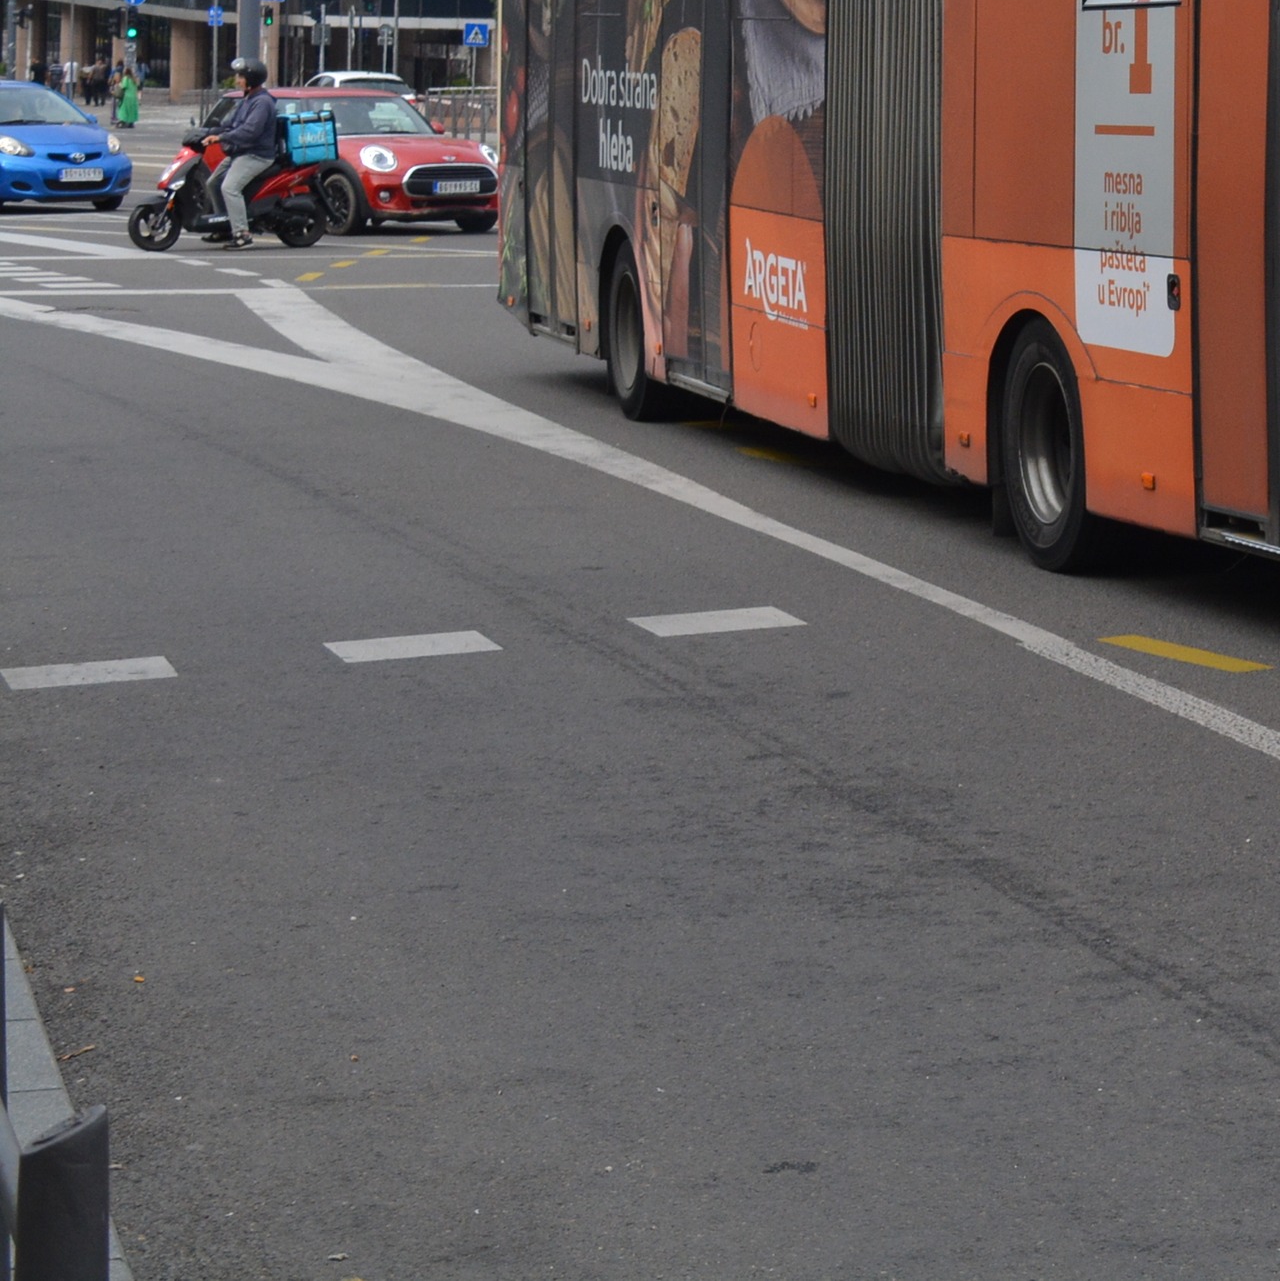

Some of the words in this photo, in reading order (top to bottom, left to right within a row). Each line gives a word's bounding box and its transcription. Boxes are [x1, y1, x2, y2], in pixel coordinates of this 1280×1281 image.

[1101, 9, 1126, 54] br.
[581, 55, 616, 107] Dobra
[618, 63, 657, 110] strana
[1103, 170, 1143, 196] mesna
[1104, 201, 1109, 231] i
[1110, 203, 1142, 240] riblja
[1100, 240, 1146, 274] pašteta
[744, 237, 808, 320] ARGETA
[1097, 285, 1105, 305] u
